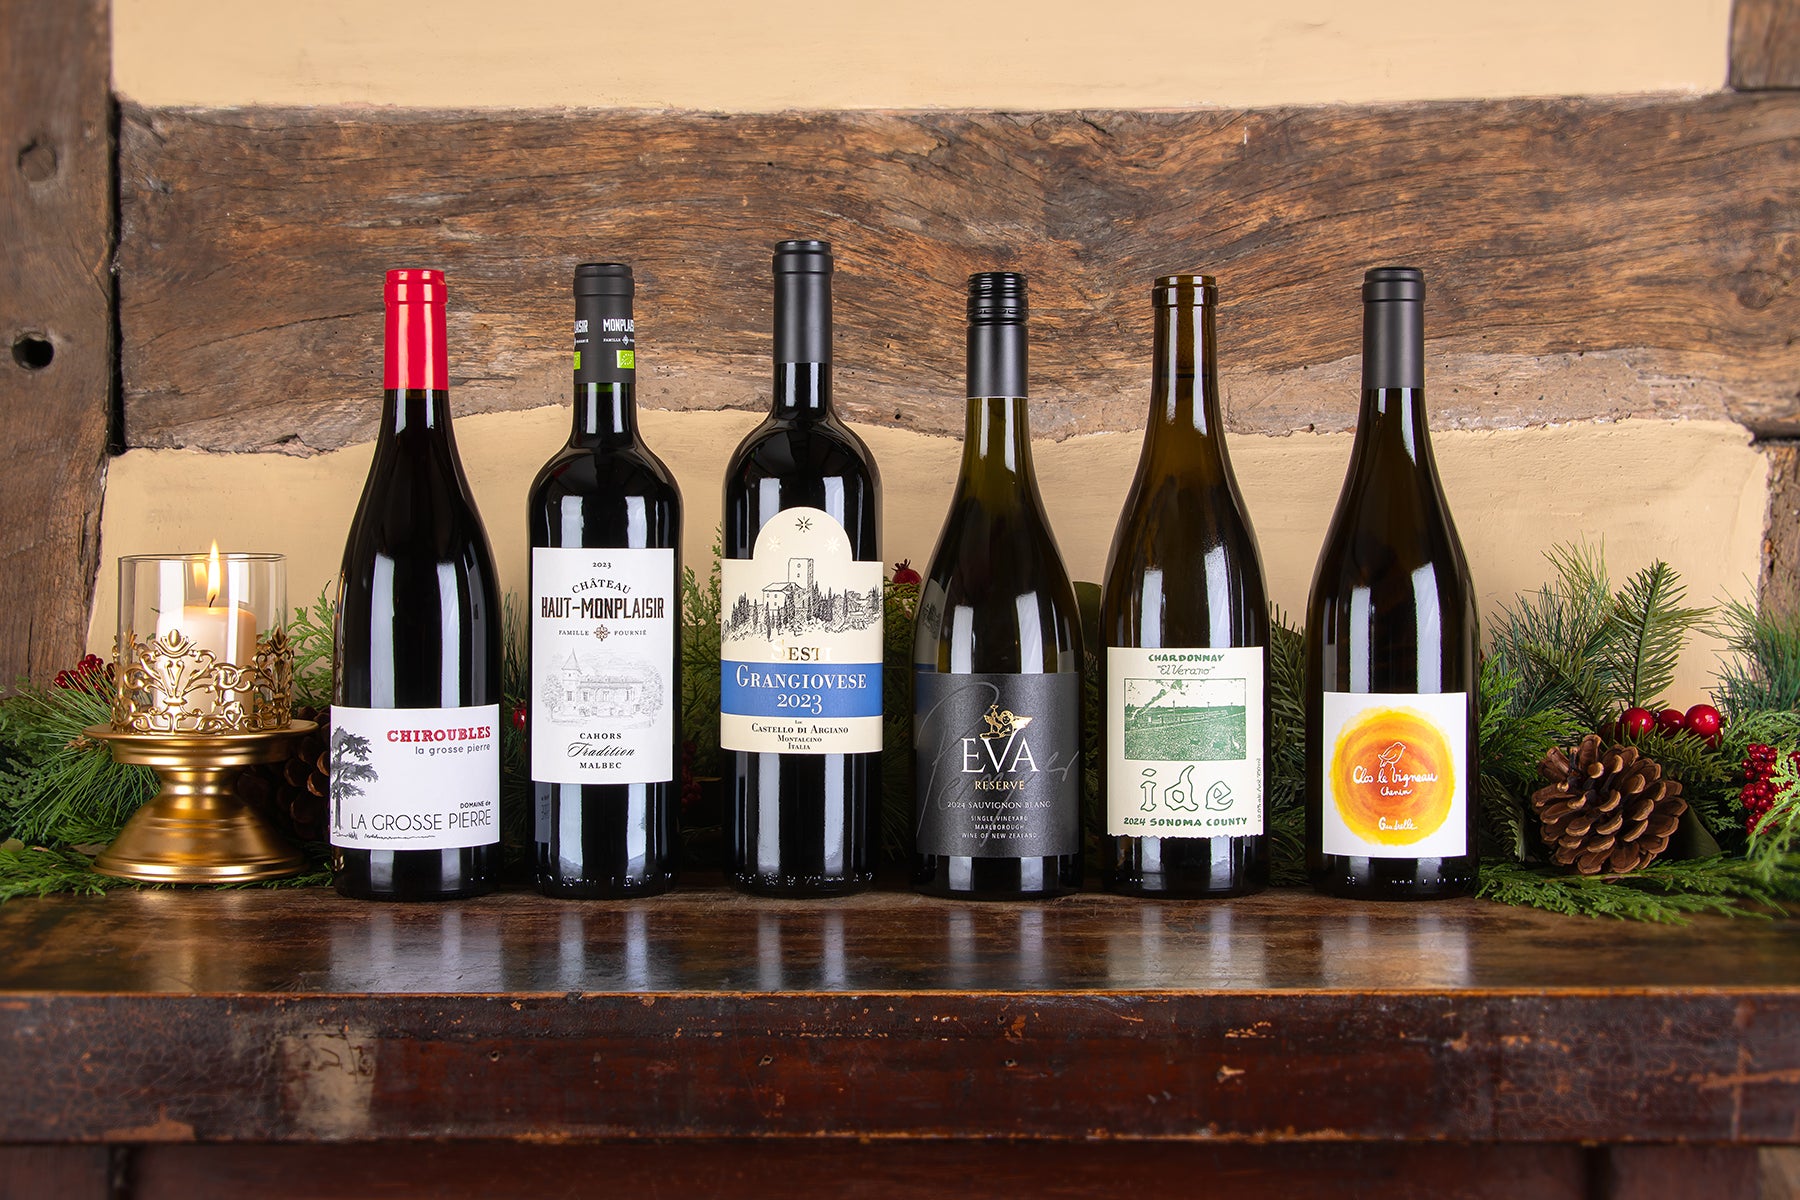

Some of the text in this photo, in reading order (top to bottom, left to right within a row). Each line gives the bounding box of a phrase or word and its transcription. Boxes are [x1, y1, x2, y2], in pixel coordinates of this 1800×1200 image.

[592, 562, 612, 570] 2023
[572, 578, 632, 594] CHÂTEAU
[541, 596, 664, 619] HAUT-MONPLAISIR
[614, 628, 647, 636] FOURNIÉ
[1148, 654, 1224, 662] CHARDONNAY
[736, 664, 867, 690] GRANGIOVESE
[776, 694, 823, 715] 2023
[386, 726, 491, 743] CHIROUBLES
[752, 722, 794, 734] CASTELLO
[810, 724, 848, 734] ARGIANO
[579, 732, 622, 740] CAHORS
[778, 734, 822, 742] MONTALCINO
[415, 743, 491, 757] la grosse pierre
[567, 742, 635, 758] Tradition
[960, 728, 1040, 773] EVA
[579, 762, 622, 770] MALBEC
[1353, 765, 1374, 784] Clos
[1377, 768, 1388, 784] le
[974, 780, 1025, 790] RESERVE
[1140, 764, 1234, 812] ide
[1380, 786, 1412, 796] Chenin
[968, 801, 1022, 809] SAUVIGNON
[1024, 800, 1052, 808] BLANC
[351, 809, 491, 831] LA GROSSE PIERRE
[1124, 817, 1248, 827] 2024 SONOMA COUNTY
